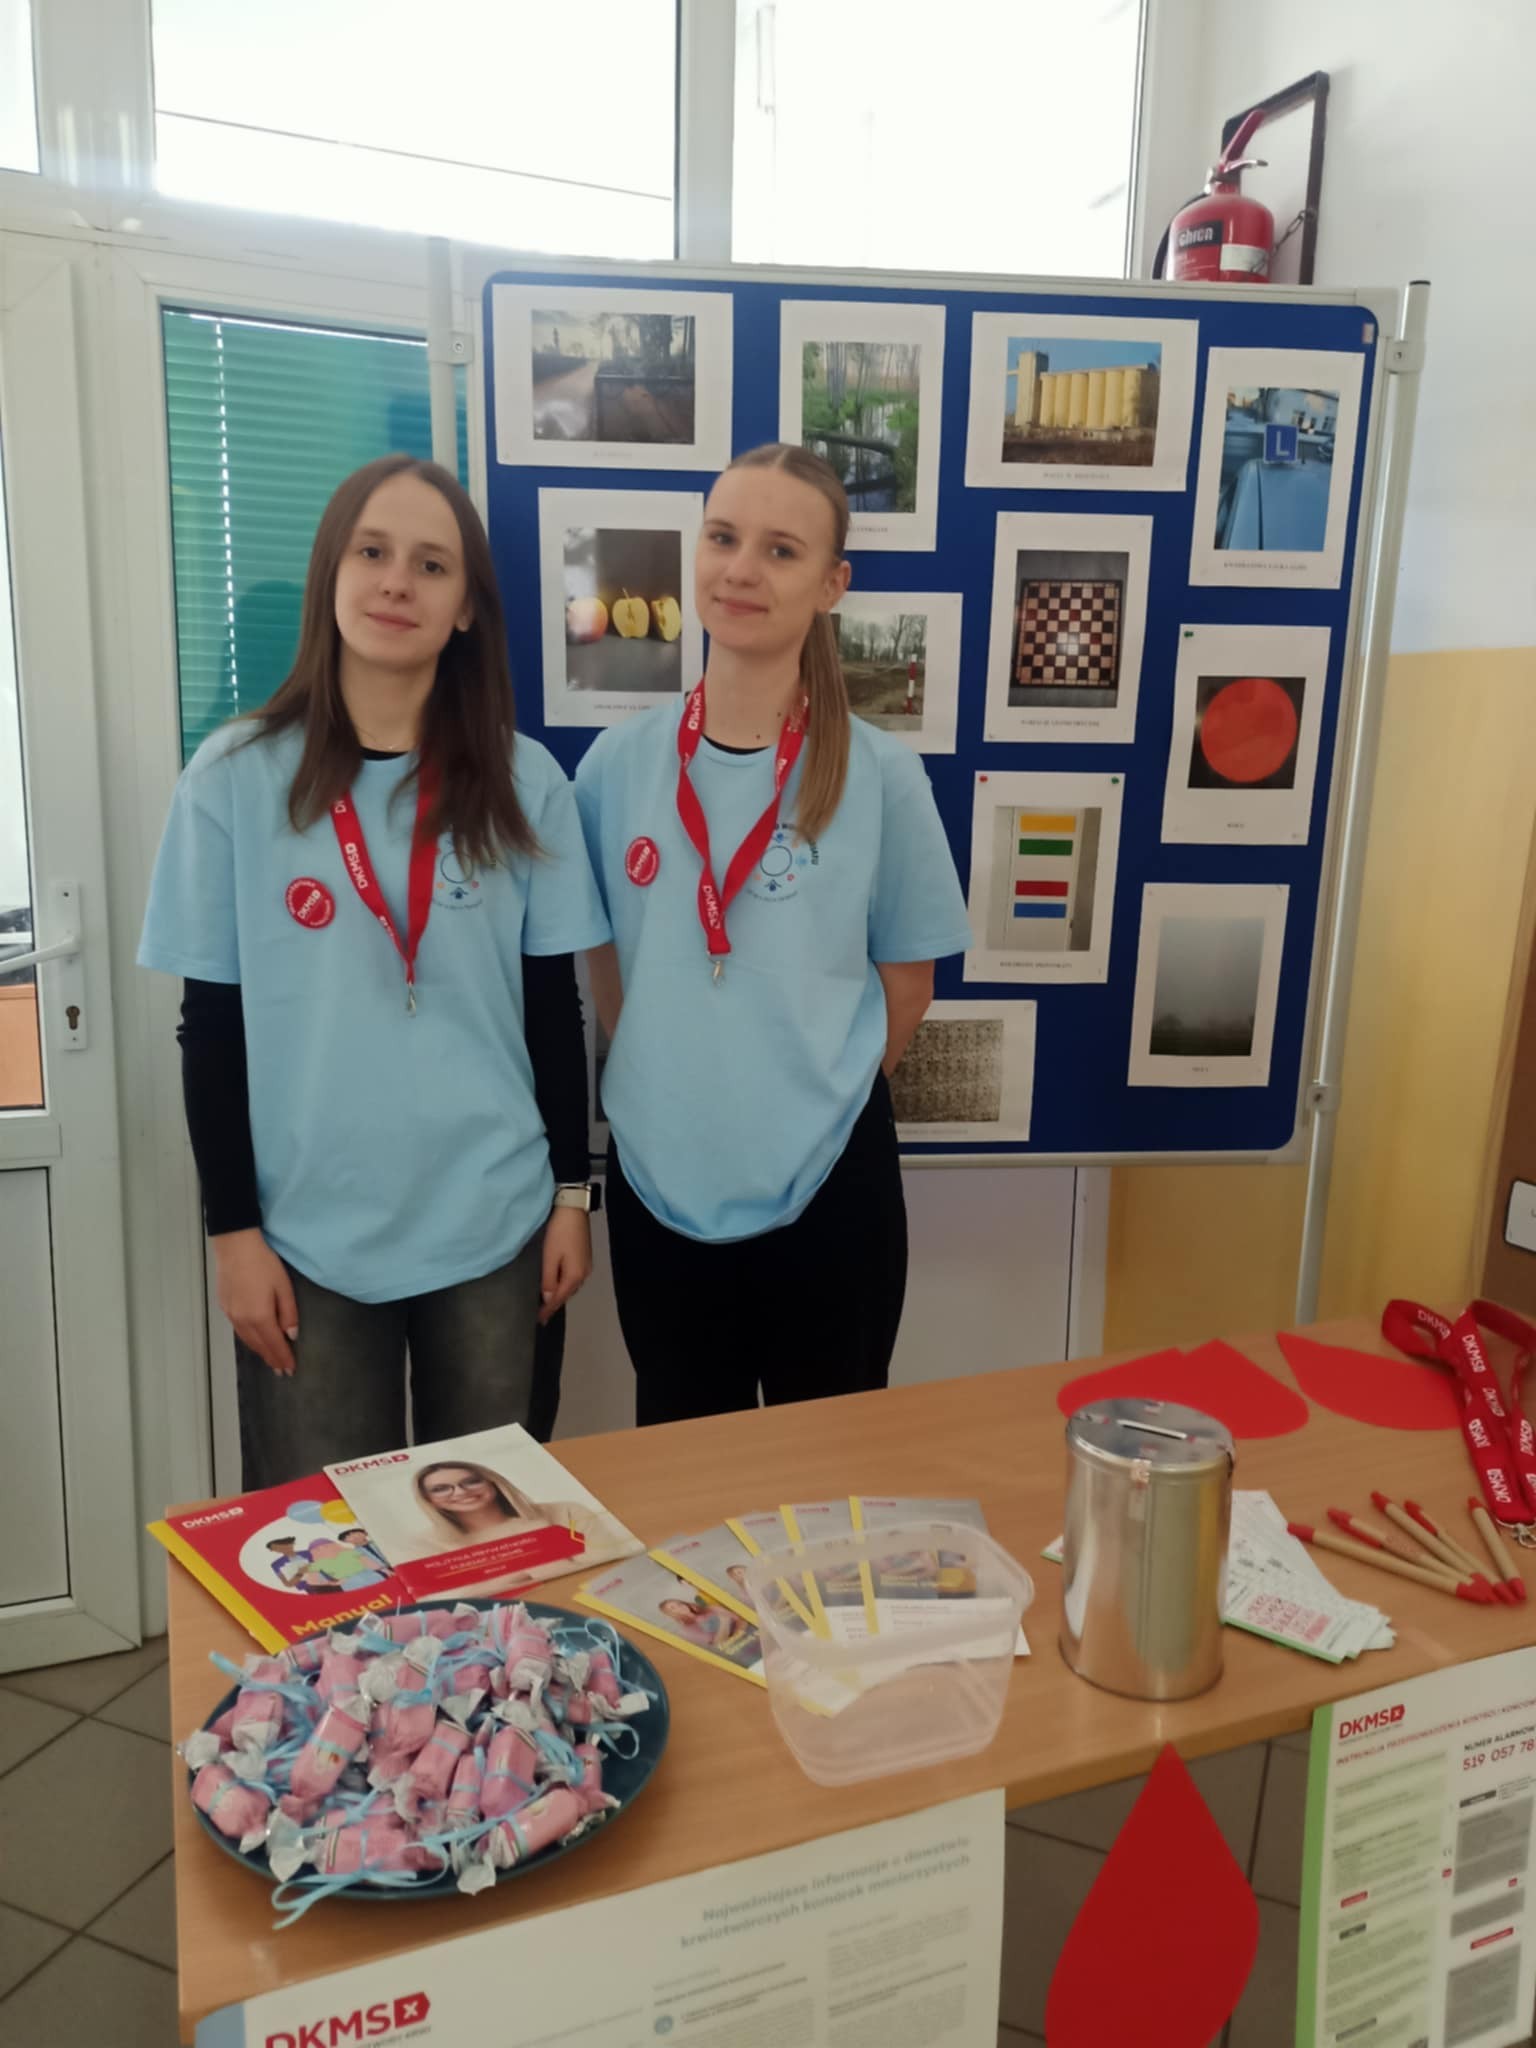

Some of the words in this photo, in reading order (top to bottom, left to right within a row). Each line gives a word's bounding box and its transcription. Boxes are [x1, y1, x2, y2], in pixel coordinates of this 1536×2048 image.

[1276, 431, 1291, 457] L
[346, 849, 369, 889] DKMS
[703, 885, 719, 923] DKMS
[1462, 1334, 1484, 1370] DKMS
[334, 1456, 391, 1475] DKMS
[1490, 1472, 1511, 1503] DKMS
[182, 1511, 229, 1529] DKMS
[290, 1594, 393, 1636] Manual
[1339, 1709, 1391, 1740] DKMS
[1463, 1752, 1486, 1771] 519
[1490, 1744, 1516, 1763] 057
[1464, 1736, 1493, 1752] NUMER
